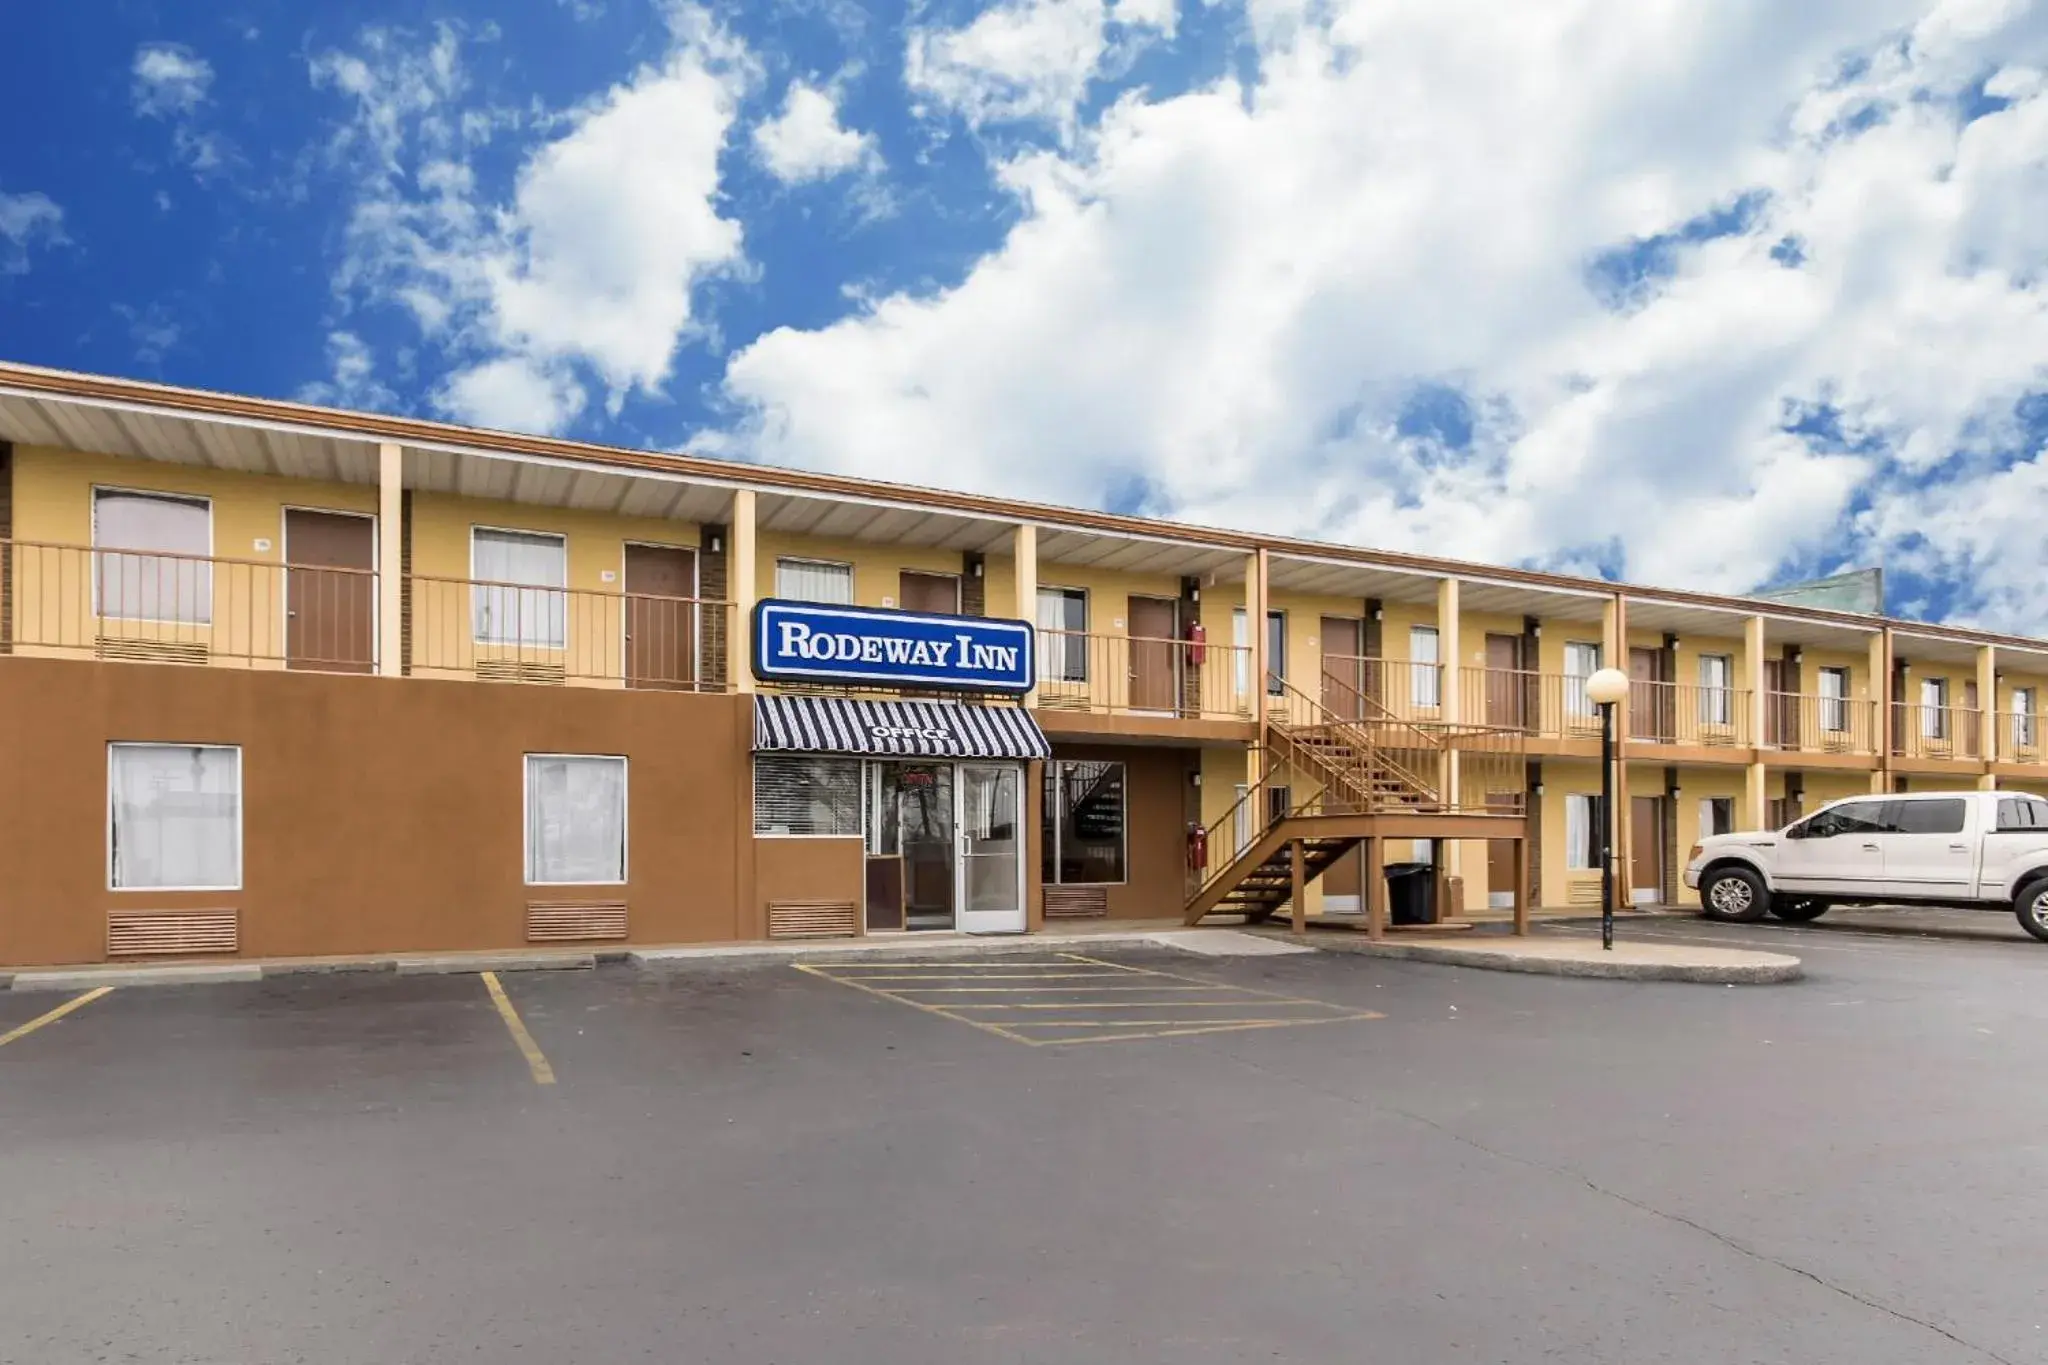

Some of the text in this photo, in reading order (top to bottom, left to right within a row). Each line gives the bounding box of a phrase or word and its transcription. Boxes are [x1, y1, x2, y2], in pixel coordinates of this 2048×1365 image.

[777, 621, 1019, 671] RODEWAY INN
[871, 726, 951, 740] OFFICE
